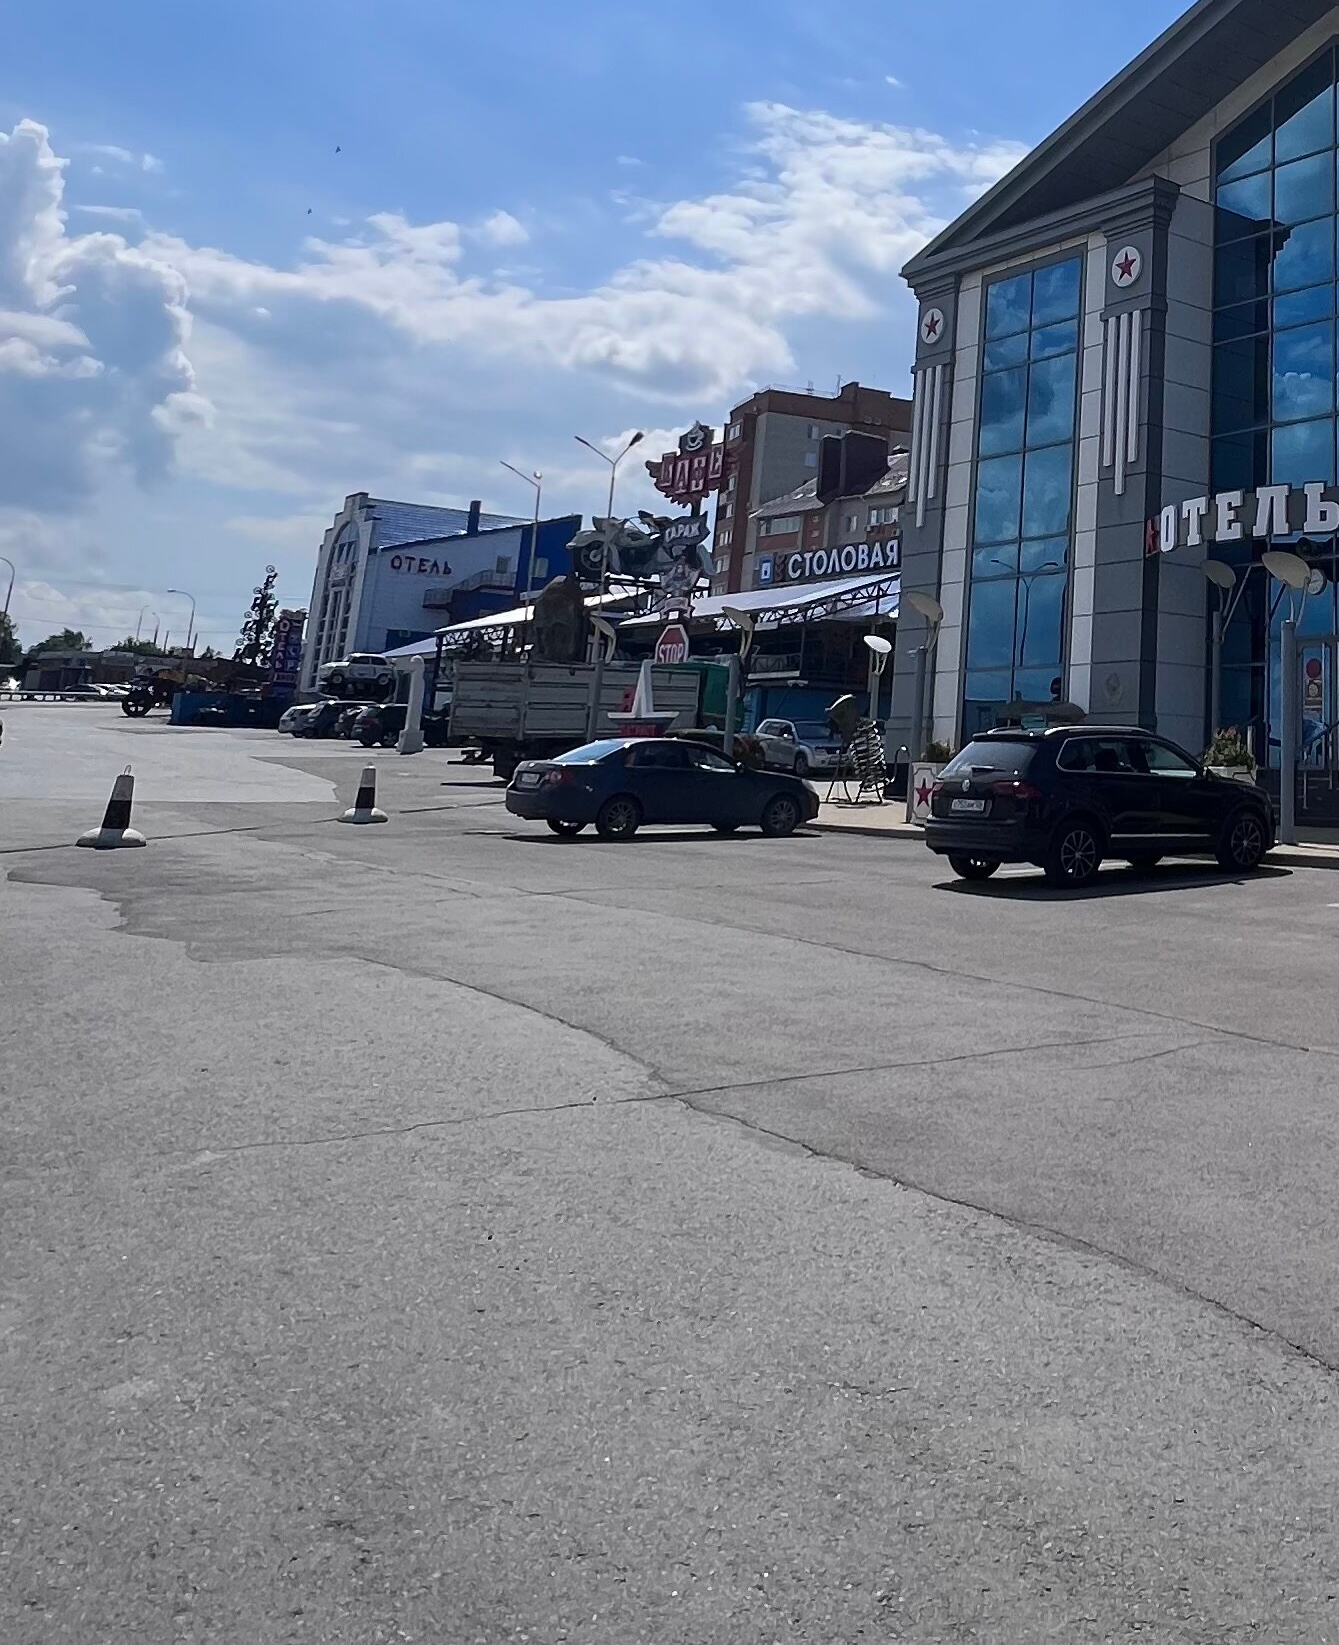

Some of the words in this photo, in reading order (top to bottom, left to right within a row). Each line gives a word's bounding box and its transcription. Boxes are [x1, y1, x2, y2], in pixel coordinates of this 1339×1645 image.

[390, 554, 453, 576] ОТЕЛЬ
[787, 539, 900, 579] СТОЛОВАЯ
[659, 643, 684, 664] STOP
